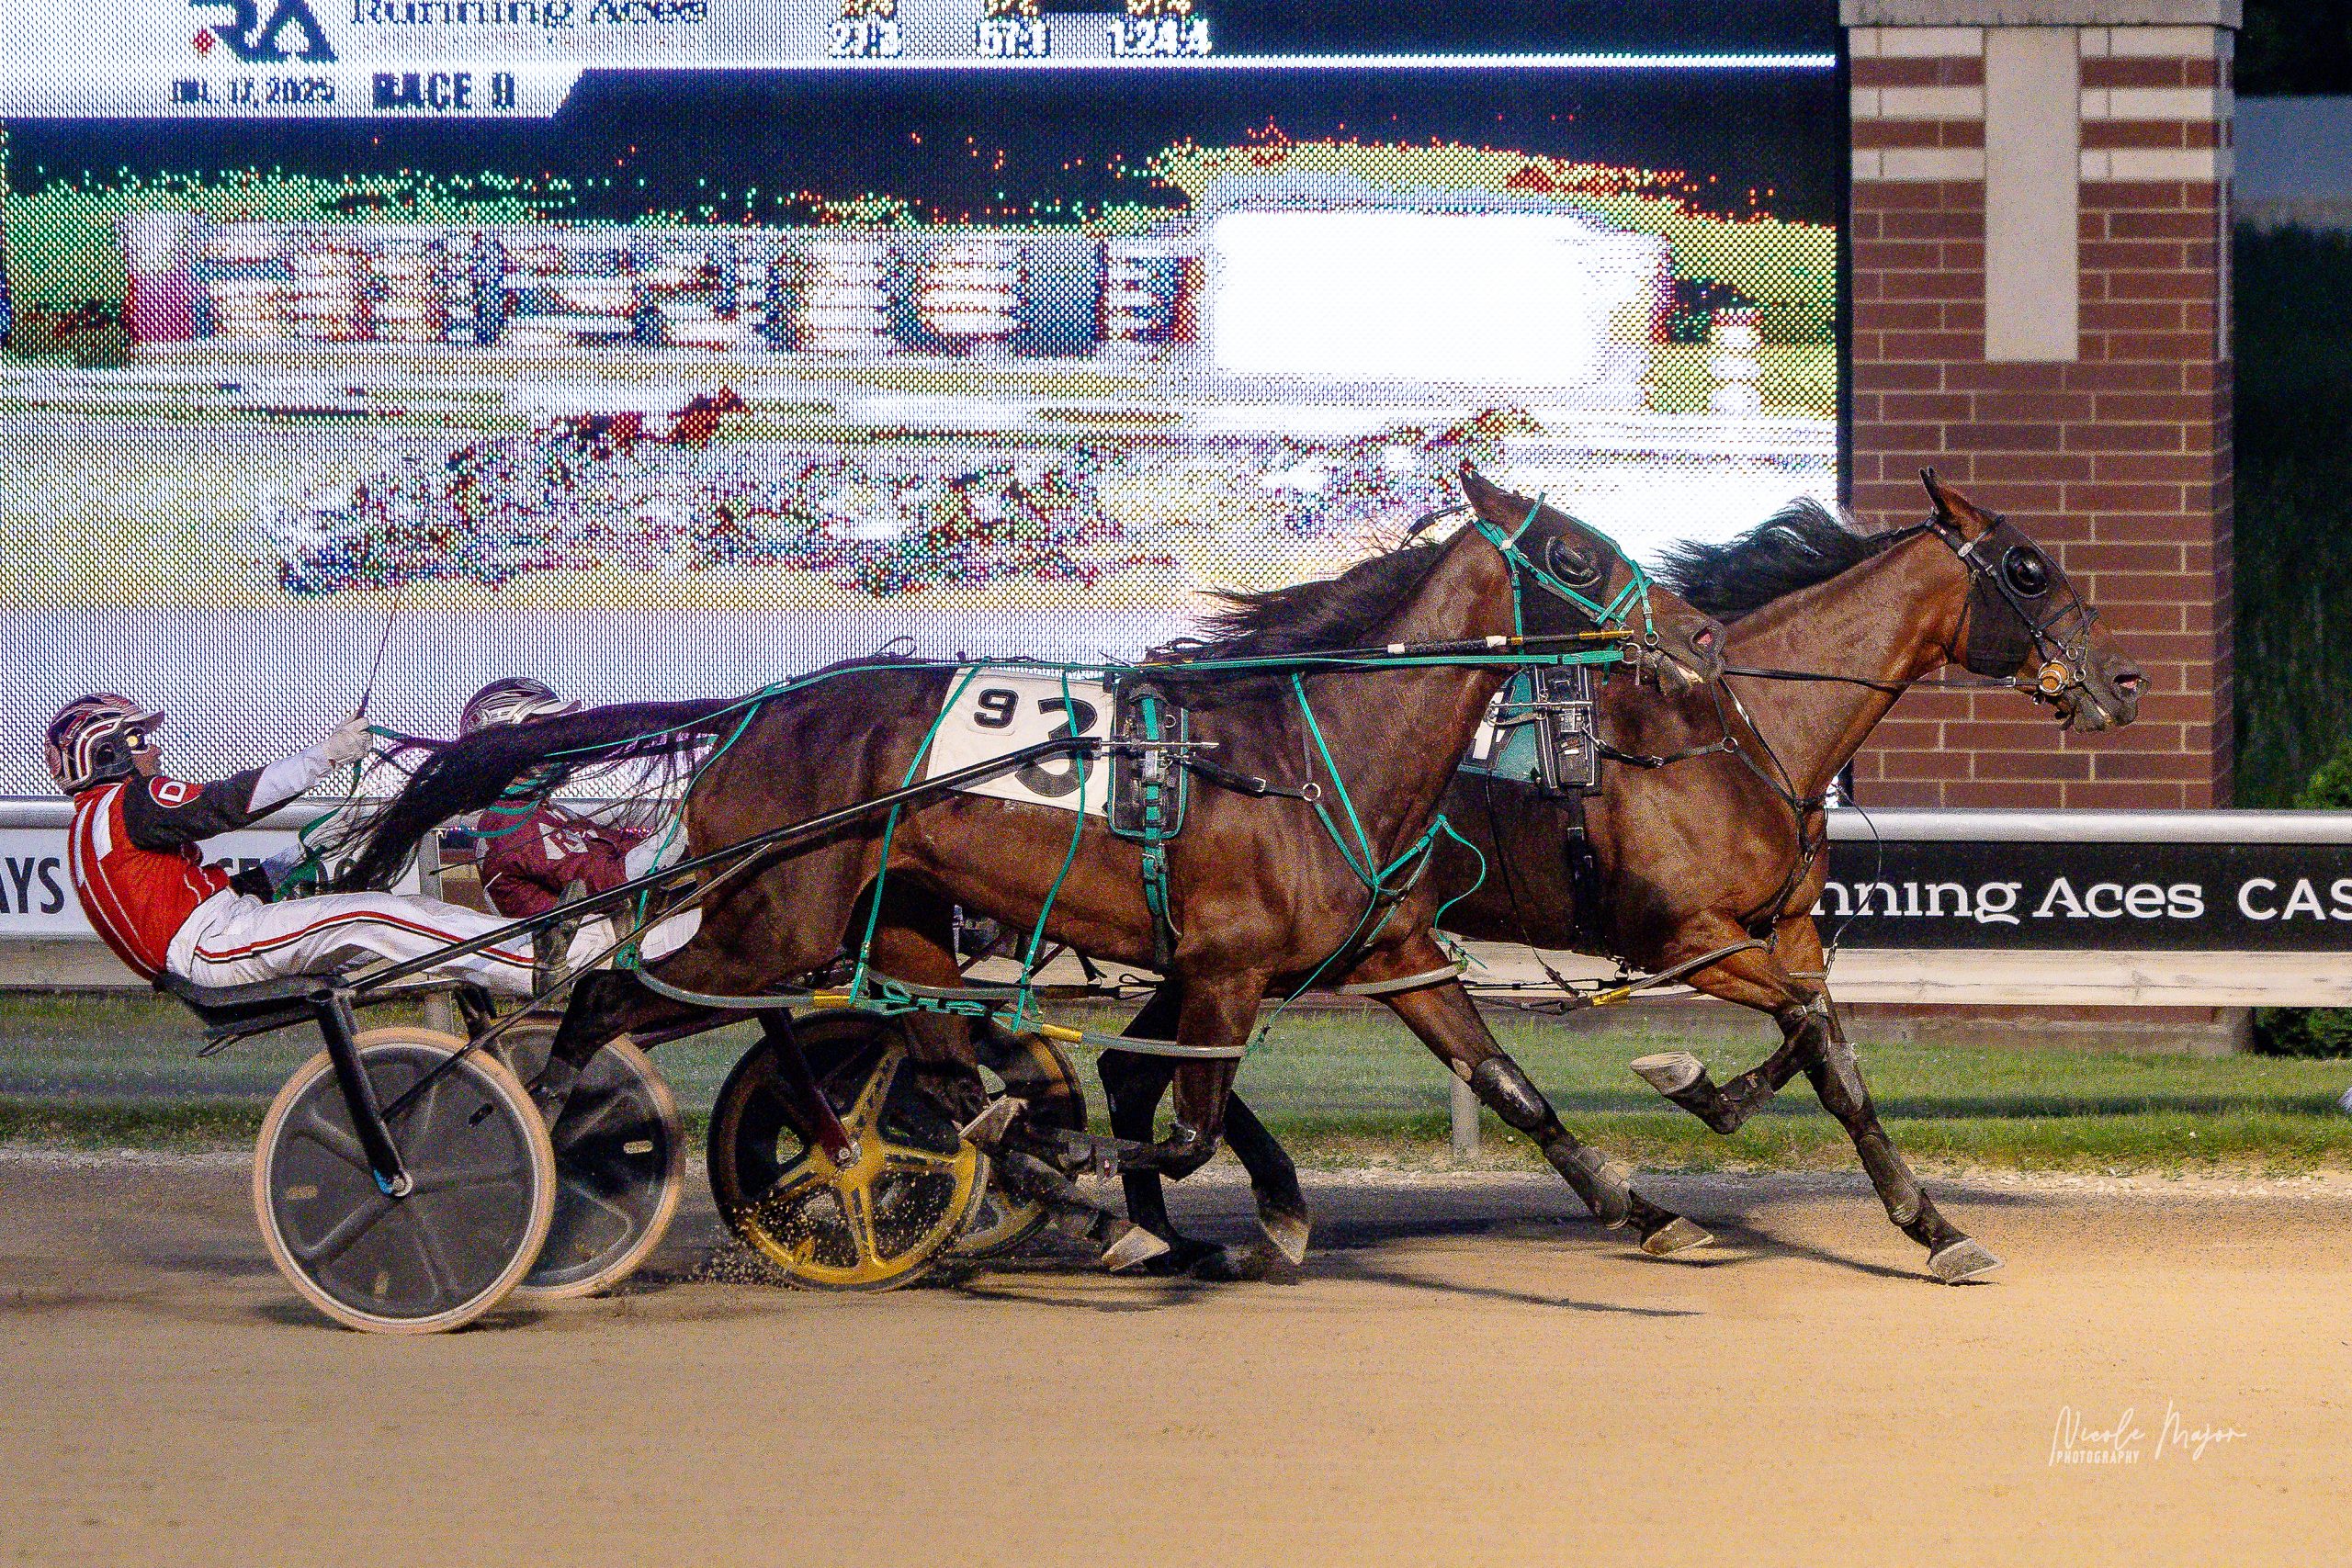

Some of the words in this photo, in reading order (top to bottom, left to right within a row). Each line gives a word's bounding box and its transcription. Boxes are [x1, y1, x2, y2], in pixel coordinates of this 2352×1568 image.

[372, 72, 472, 111] RACE
[974, 688, 1019, 728] 9
[1014, 697, 1098, 797] 3
[158, 781, 187, 803] D
[0, 857, 65, 914] YS
[2032, 877, 2203, 919] Aces
[2238, 878, 2352, 921] CAS
